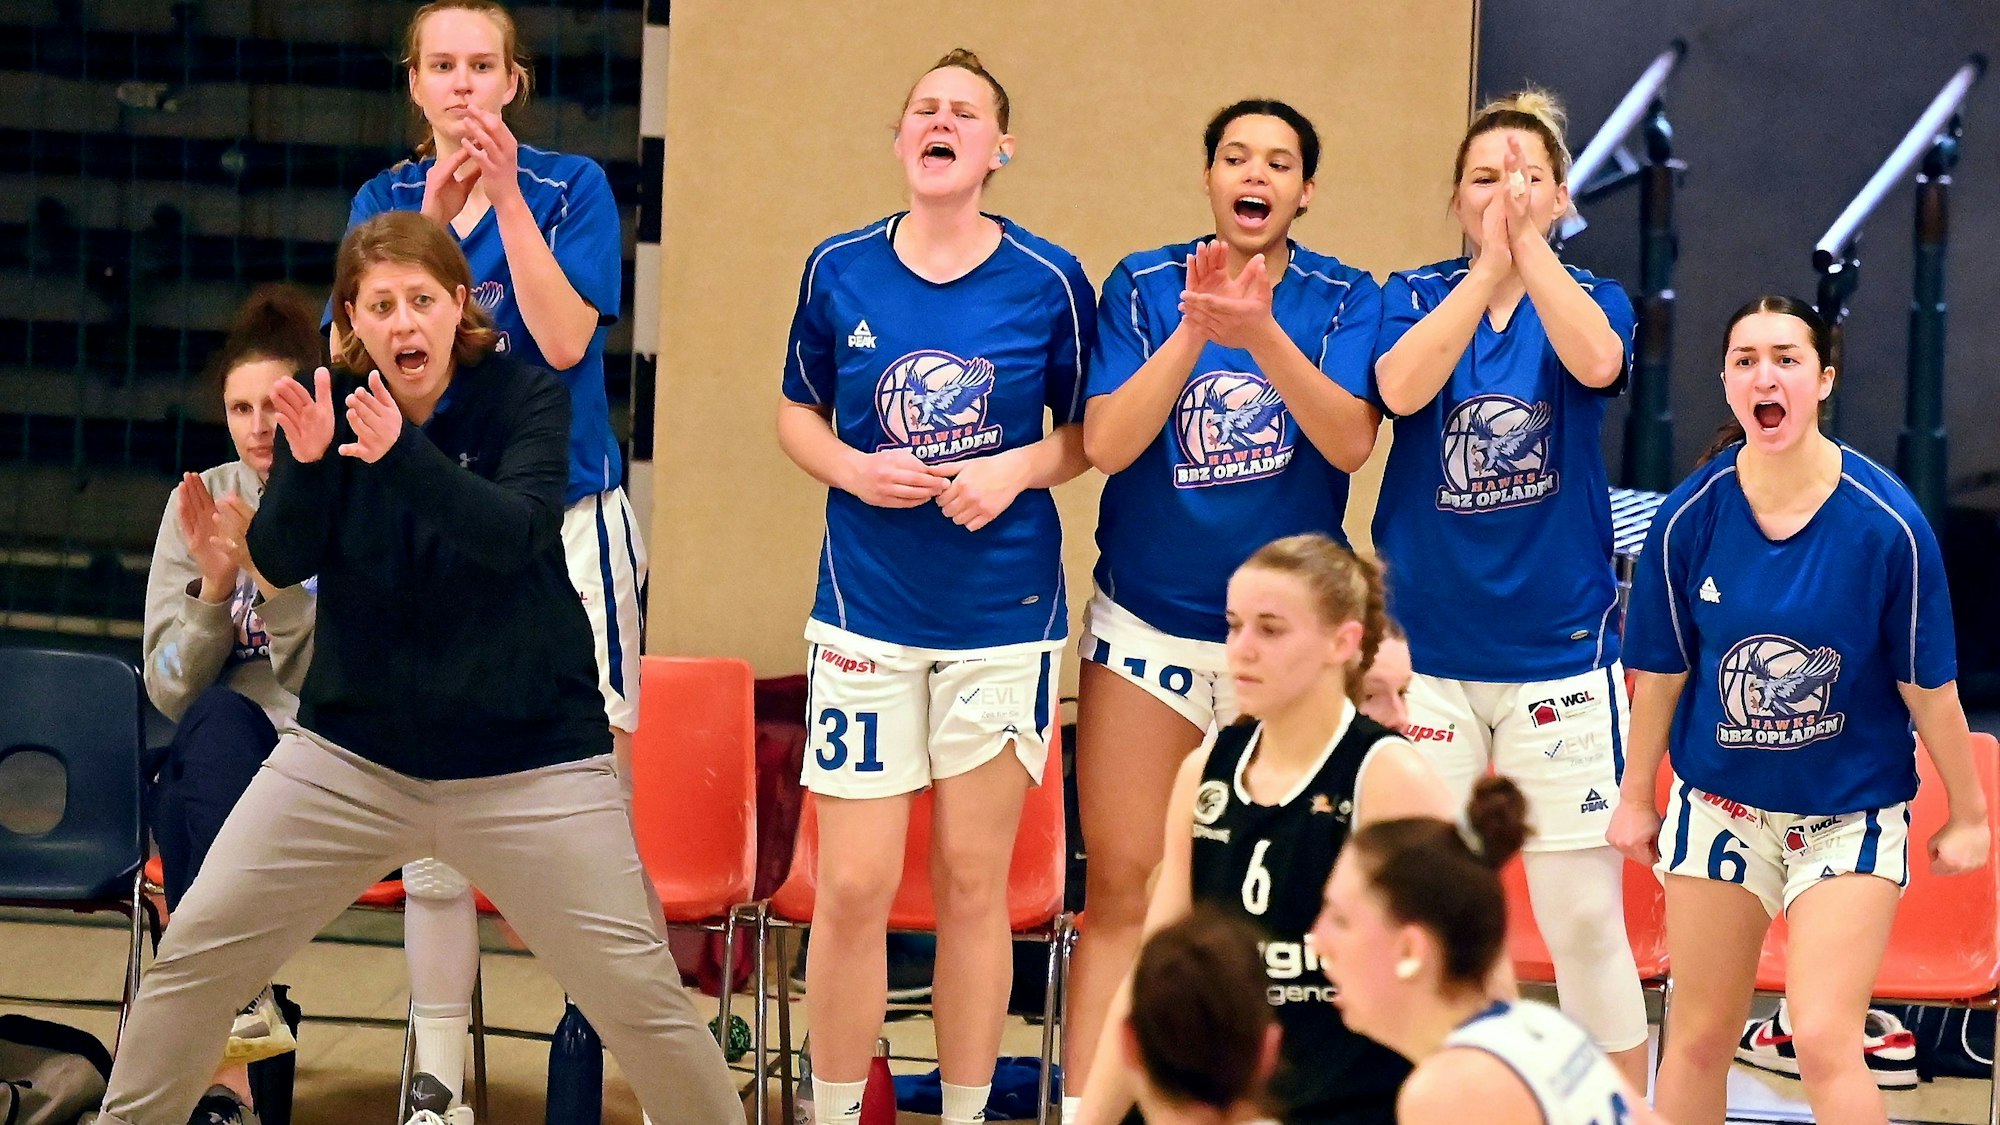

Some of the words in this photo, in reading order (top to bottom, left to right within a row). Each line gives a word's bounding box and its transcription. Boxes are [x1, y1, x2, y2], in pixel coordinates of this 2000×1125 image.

[848, 334, 877, 349] PEAK
[911, 425, 973, 446] HAWKS
[915, 430, 999, 459] OPLADEN
[1208, 446, 1273, 466] HAWKS
[1178, 467, 1210, 483] BBZ
[1471, 472, 1536, 493] HAWKS
[981, 686, 1020, 705] EVL
[1560, 690, 1595, 708] WGL
[1720, 727, 1753, 743] BBZ
[1755, 717, 1839, 744] OPLADEN
[1751, 714, 1816, 730] HAWKS
[815, 707, 884, 772] 31
[1405, 723, 1456, 743] upsi
[1810, 814, 1842, 834] WGL
[1707, 828, 1750, 885] 6
[1241, 838, 1271, 916] 6
